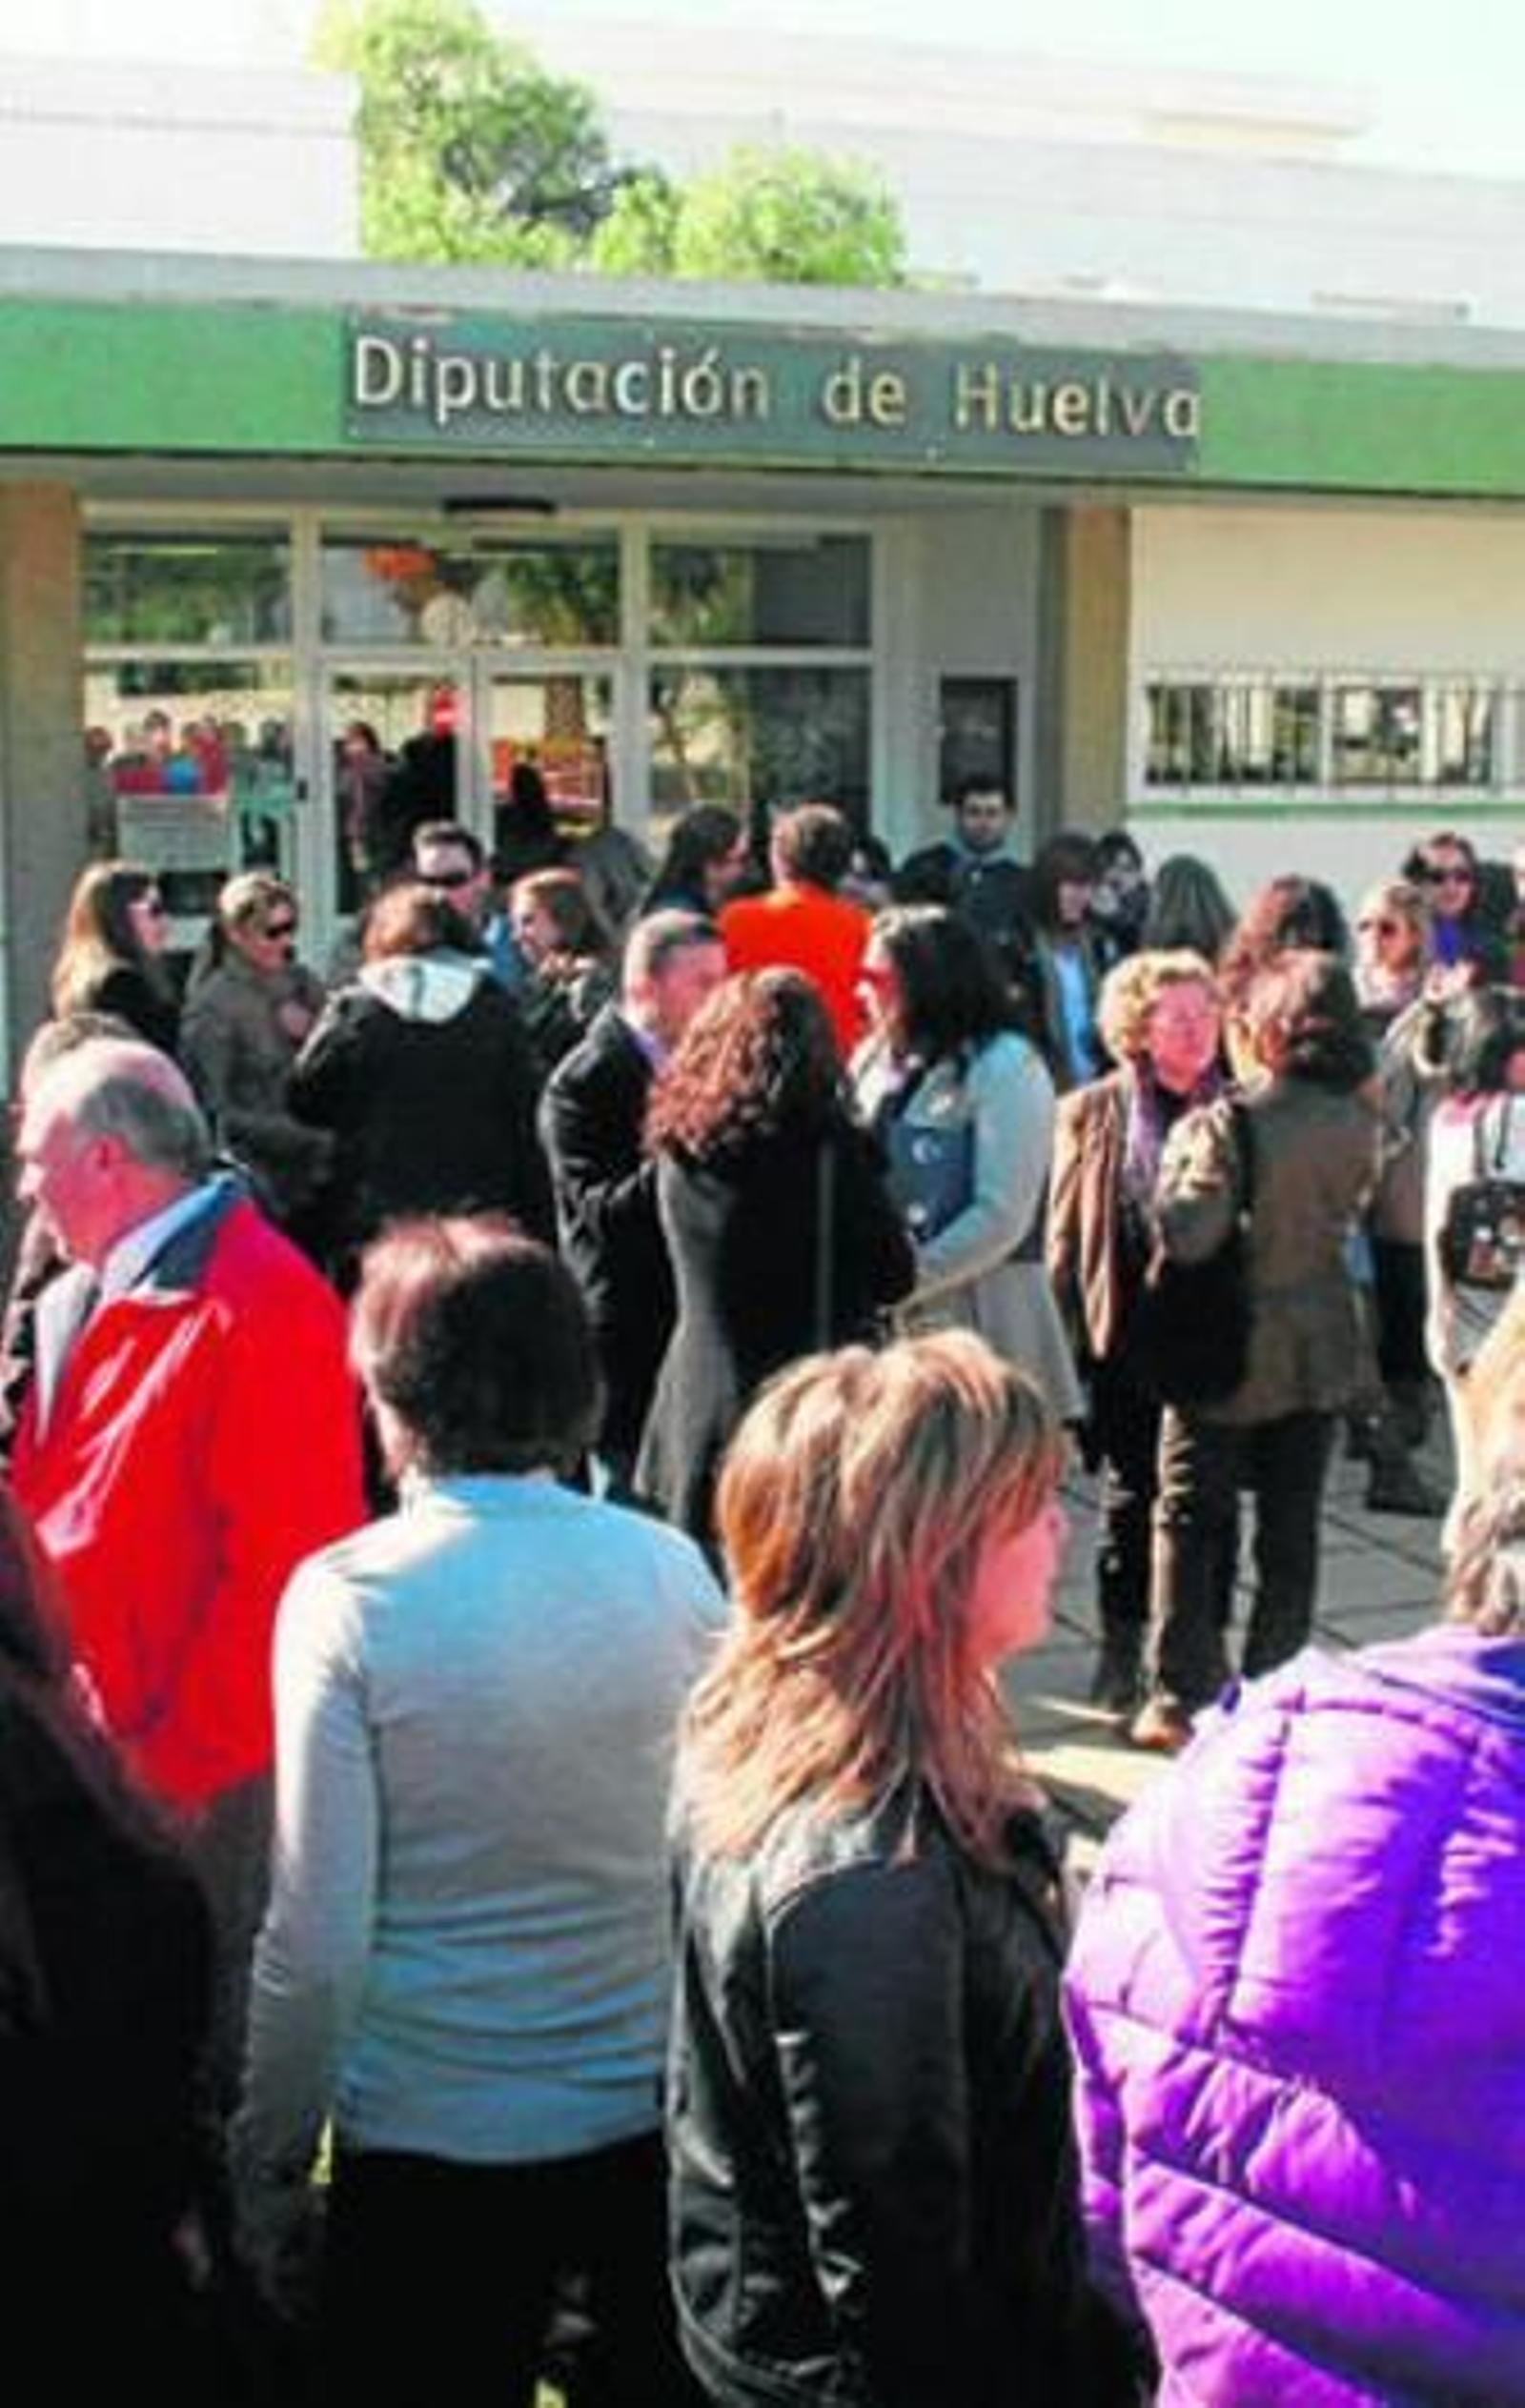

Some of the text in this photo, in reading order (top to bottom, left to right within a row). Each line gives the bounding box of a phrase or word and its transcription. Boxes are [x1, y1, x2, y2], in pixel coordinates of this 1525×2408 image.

[356, 336, 1201, 437] Diputación de Huelva
